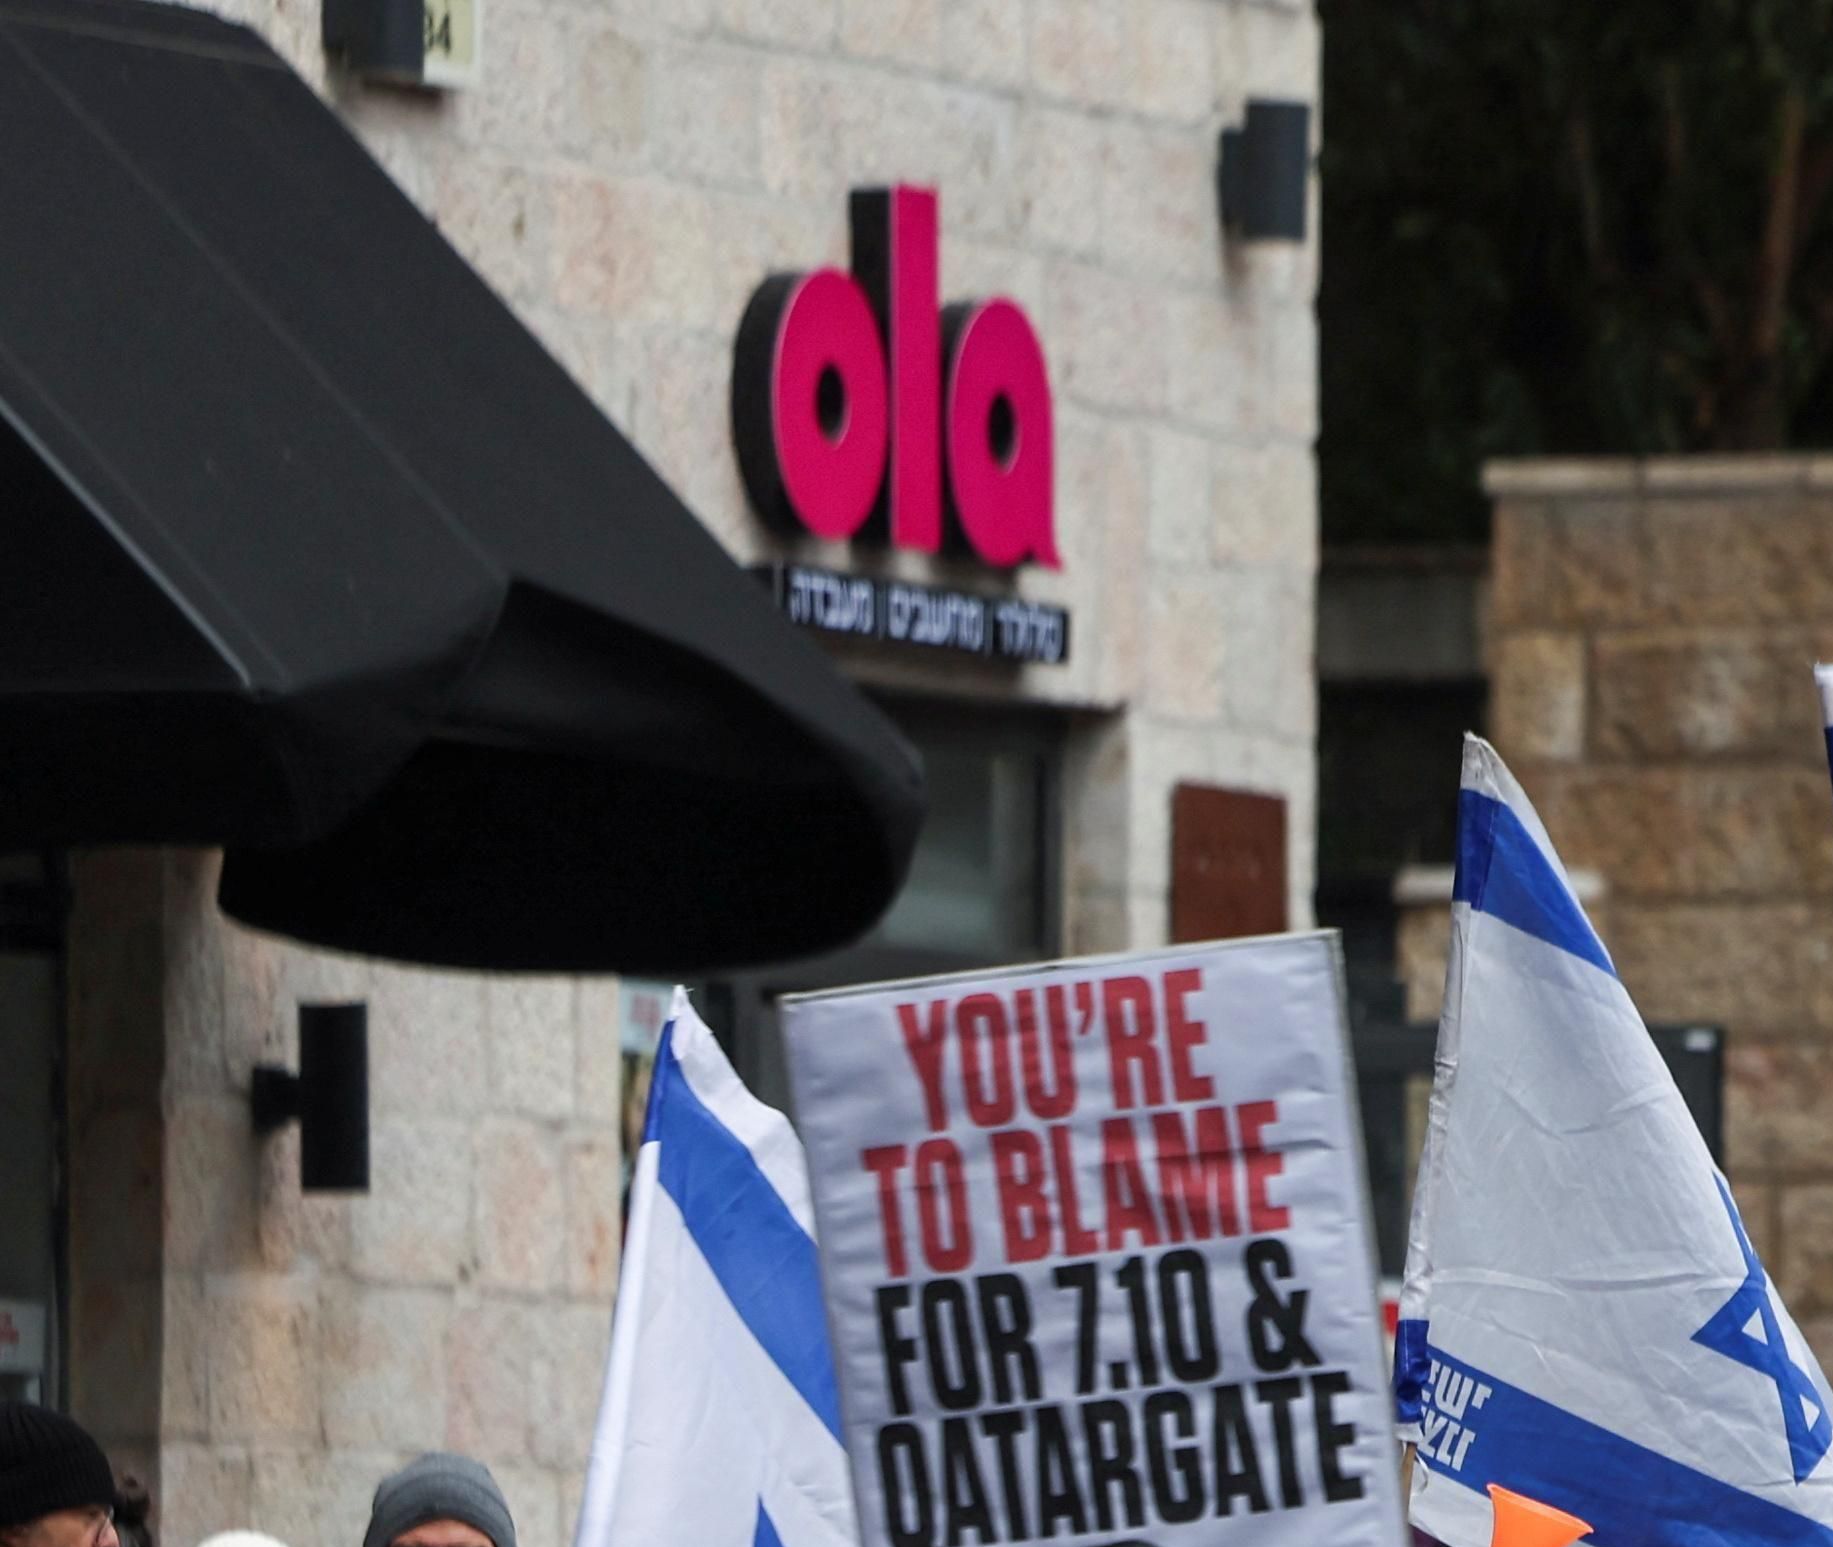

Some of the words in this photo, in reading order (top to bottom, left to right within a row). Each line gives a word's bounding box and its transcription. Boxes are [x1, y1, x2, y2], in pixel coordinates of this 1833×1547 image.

[898, 967, 1216, 1132] YOU'RE
[863, 1138, 974, 1278] TO
[990, 1100, 1291, 1265] BLAME
[876, 1273, 1042, 1417] FOR
[1055, 1247, 1223, 1397] 7.10
[1245, 1238, 1323, 1376] &
